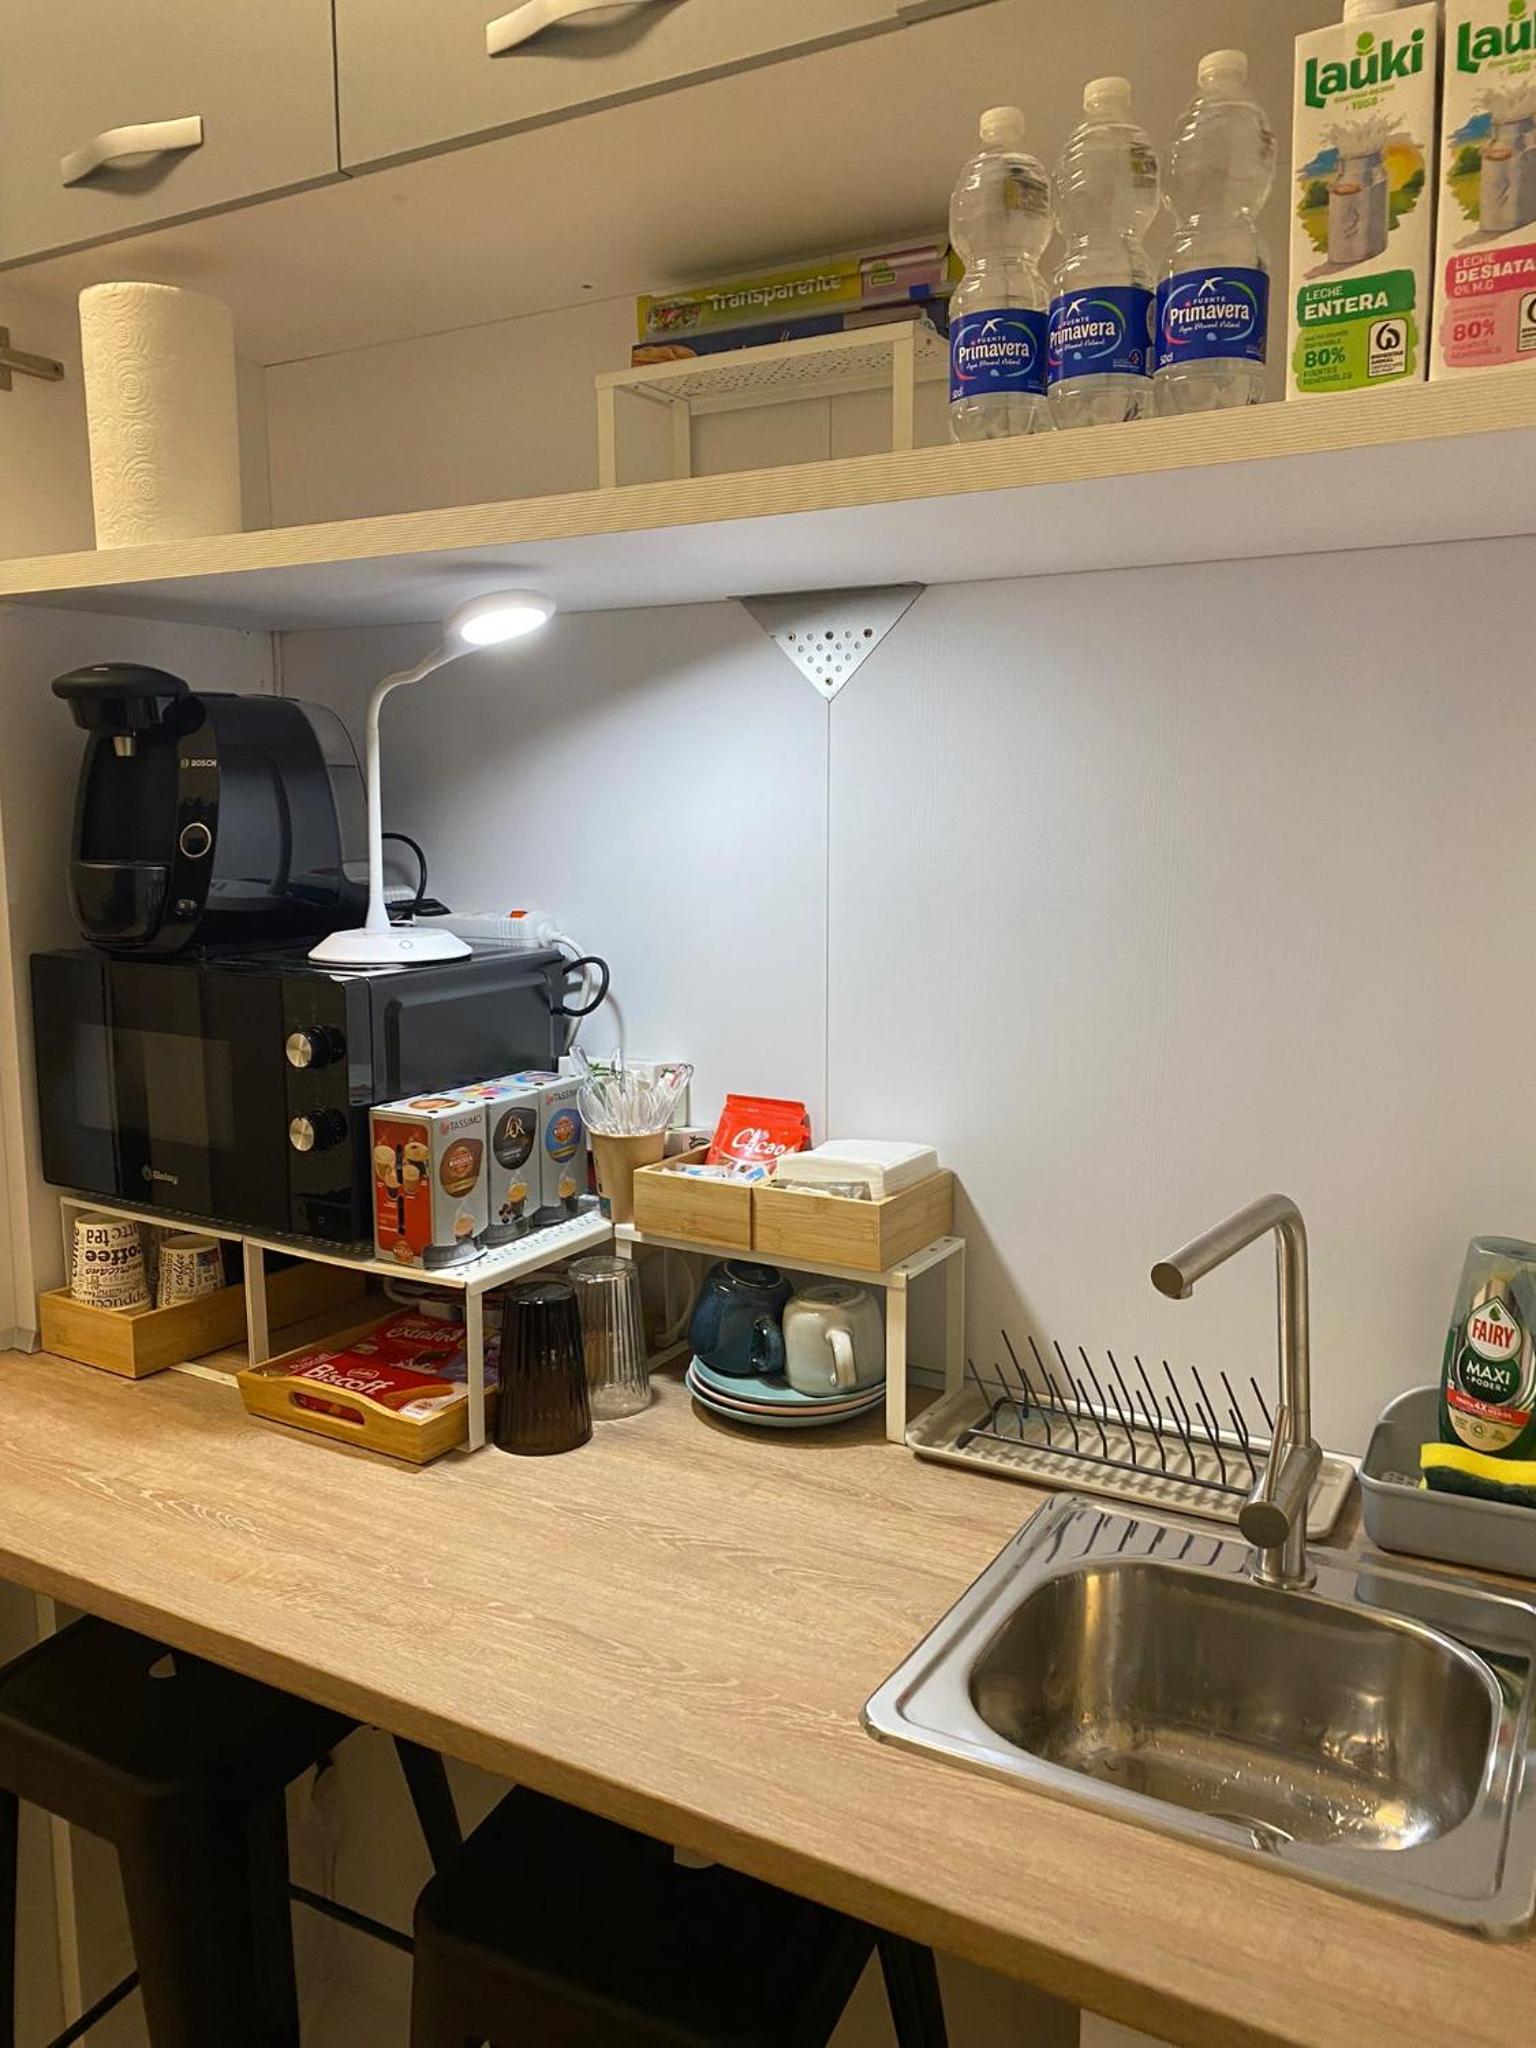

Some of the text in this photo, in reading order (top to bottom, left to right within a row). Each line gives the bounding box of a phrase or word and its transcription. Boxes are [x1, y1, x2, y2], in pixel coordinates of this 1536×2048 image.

[1457, 19, 1536, 73] Lau
[1305, 28, 1425, 109] Lauki
[706, 274, 841, 311] Transparente
[1305, 291, 1389, 320] ENTERA
[1306, 285, 1344, 301] LECHE
[1170, 301, 1249, 327] Primavera
[1454, 319, 1496, 342] 80%
[959, 341, 1030, 364] Primavera
[1305, 347, 1346, 369] 80%
[191, 759, 217, 768] BOSCH
[86, 1229, 110, 1247] tea
[1472, 1318, 1515, 1349] FAIRY
[301, 1363, 395, 1394] Biscoff
[1466, 1359, 1511, 1385] MAXI
[1471, 1377, 1502, 1393] PODER
